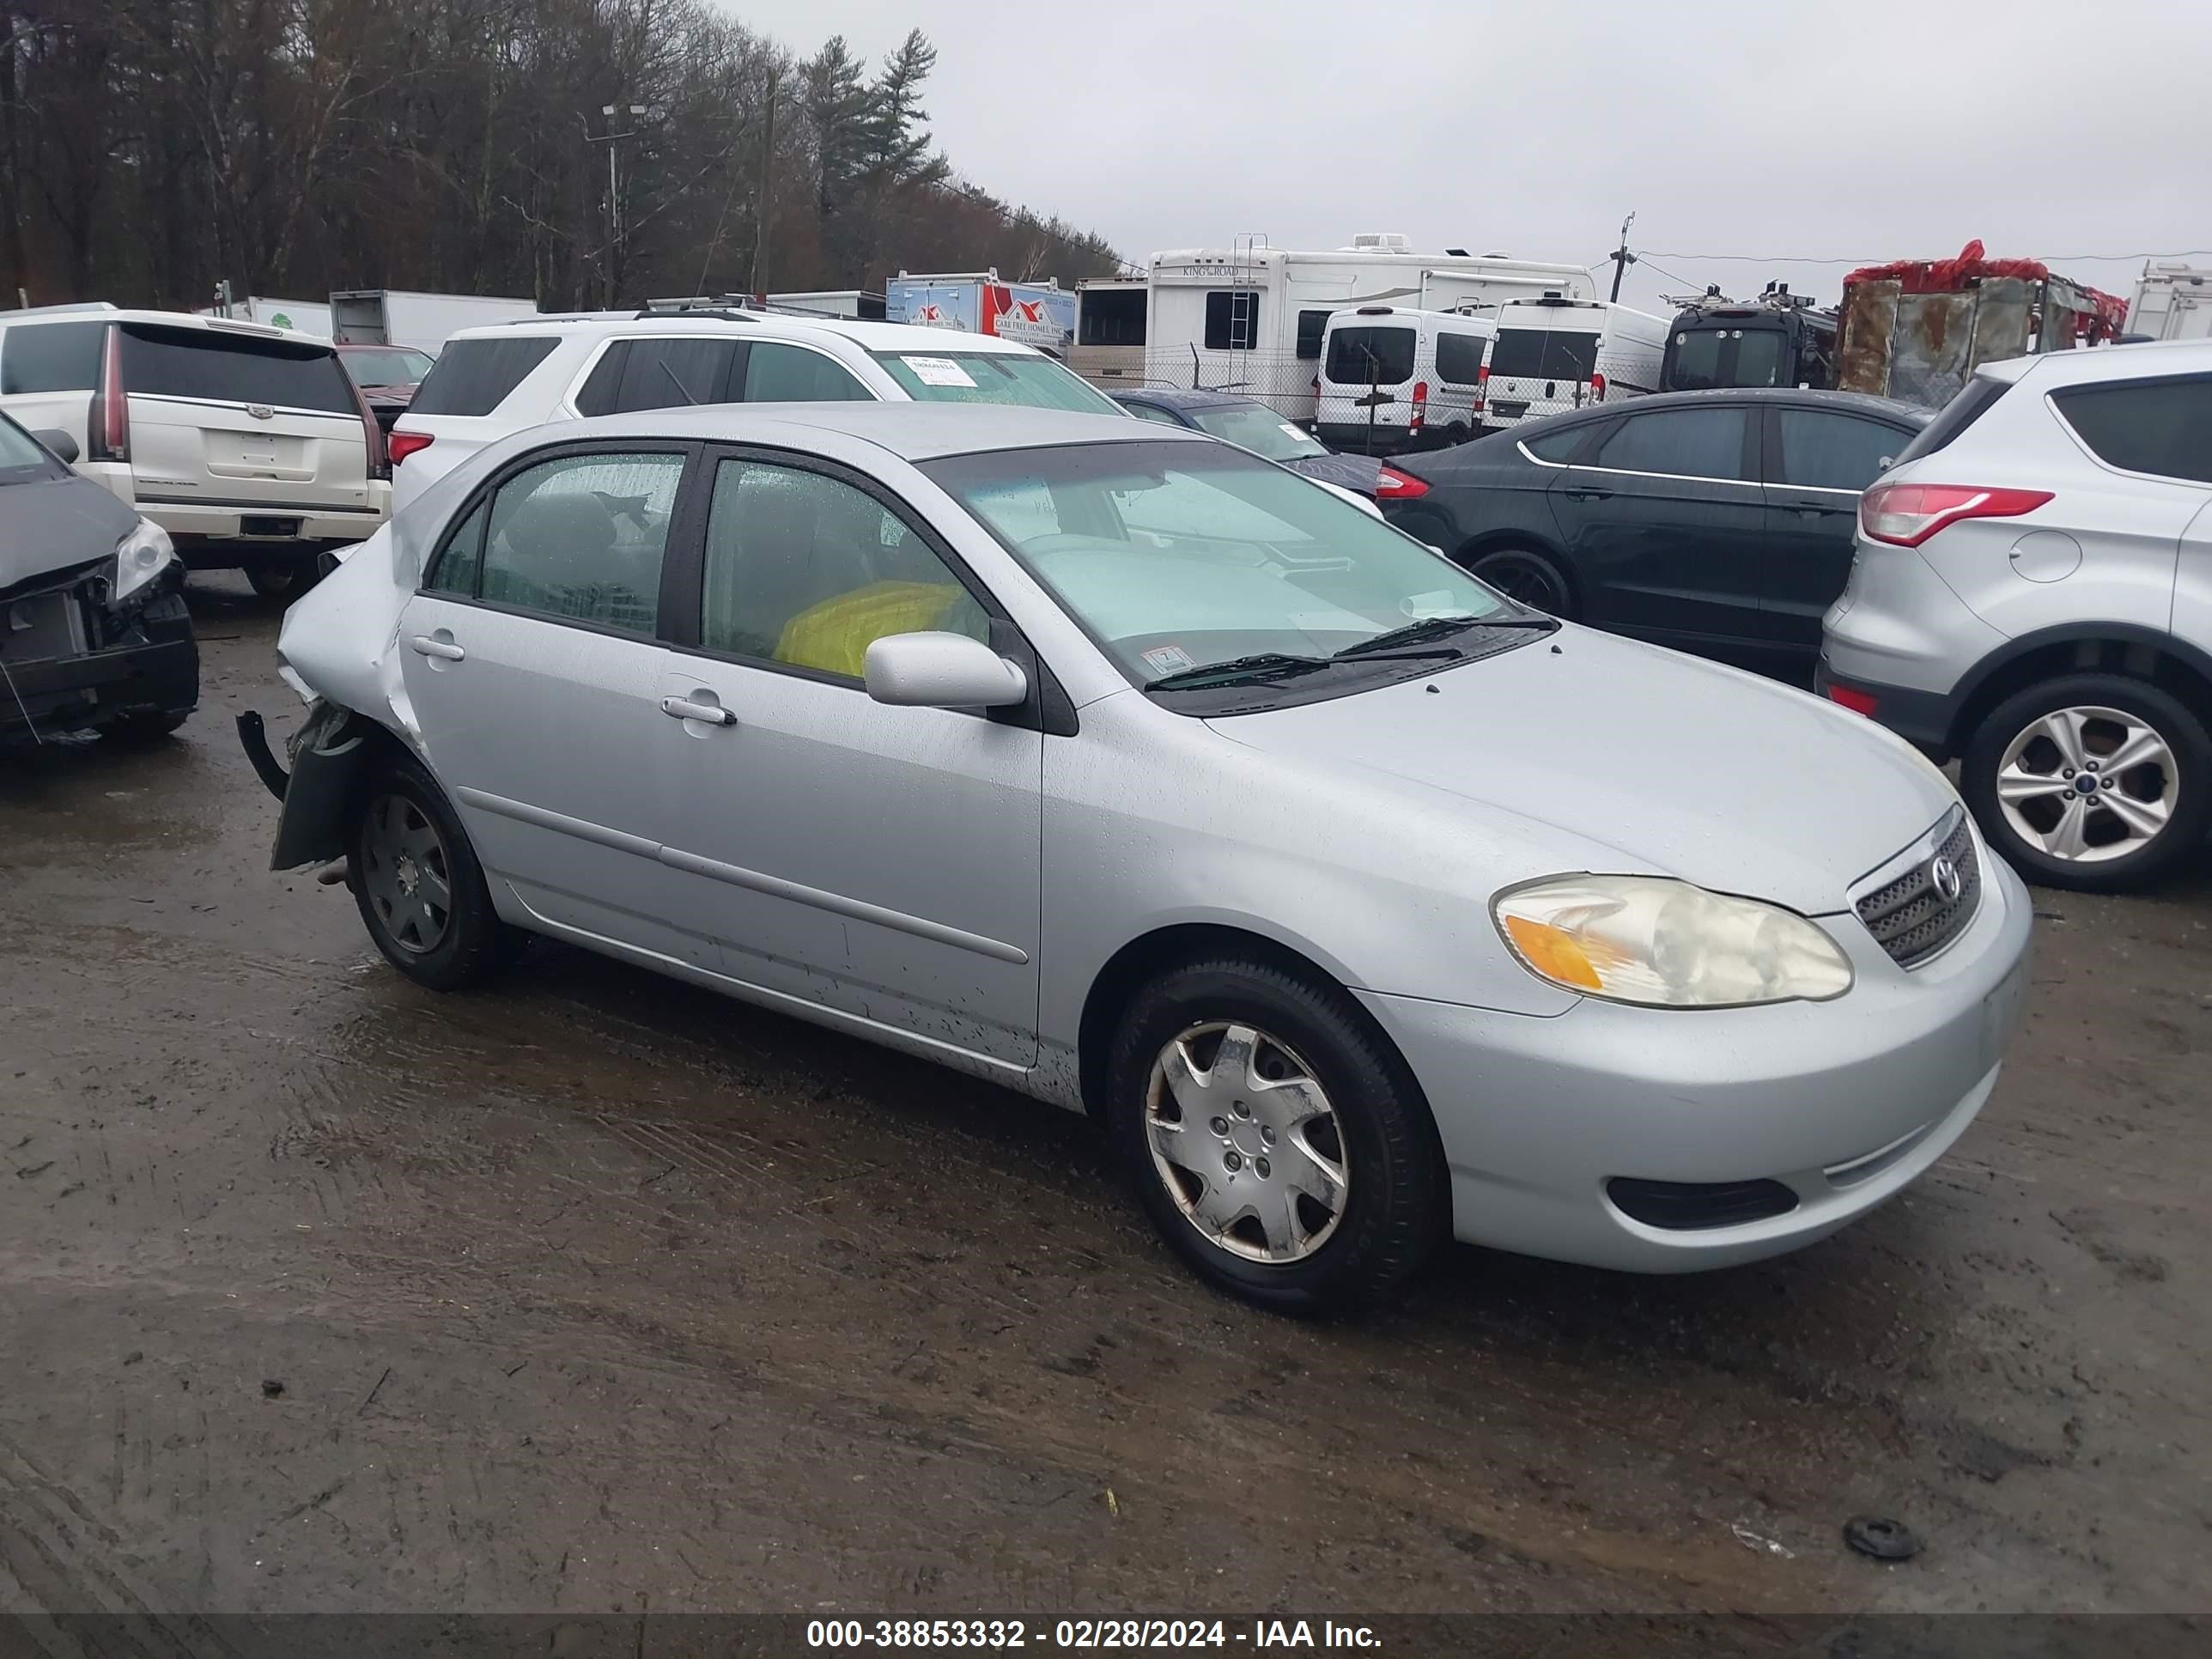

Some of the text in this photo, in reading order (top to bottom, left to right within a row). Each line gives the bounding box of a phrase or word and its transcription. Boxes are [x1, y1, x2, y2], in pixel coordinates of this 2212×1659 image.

[1183, 266, 1206, 276] KING
[1214, 266, 1239, 276] ROAD
[995, 319, 1012, 330] CARE
[1012, 321, 1027, 331] FREE
